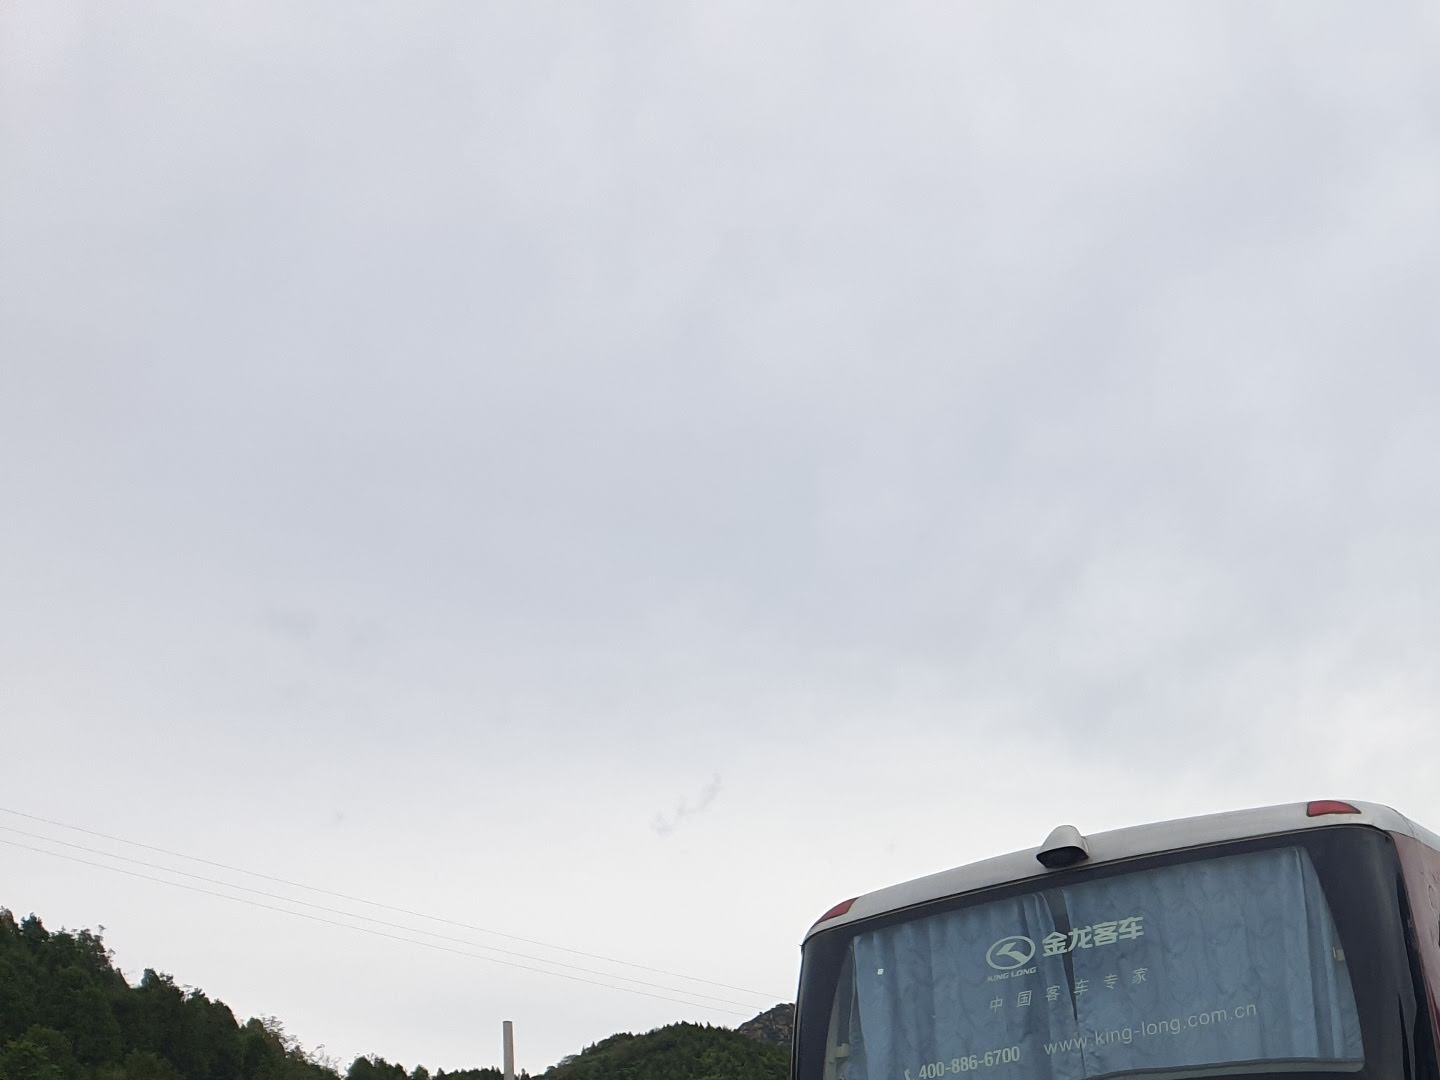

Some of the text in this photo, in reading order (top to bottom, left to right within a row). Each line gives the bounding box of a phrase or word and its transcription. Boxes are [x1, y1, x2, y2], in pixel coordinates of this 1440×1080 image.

[1042, 916, 1144, 957] 金龙客车
[986, 966, 1037, 983] KING LONG
[990, 967, 1149, 1013] 中国客车专家
[918, 1002, 1258, 1080] 400-886-6700 www.king-long.com.cn
